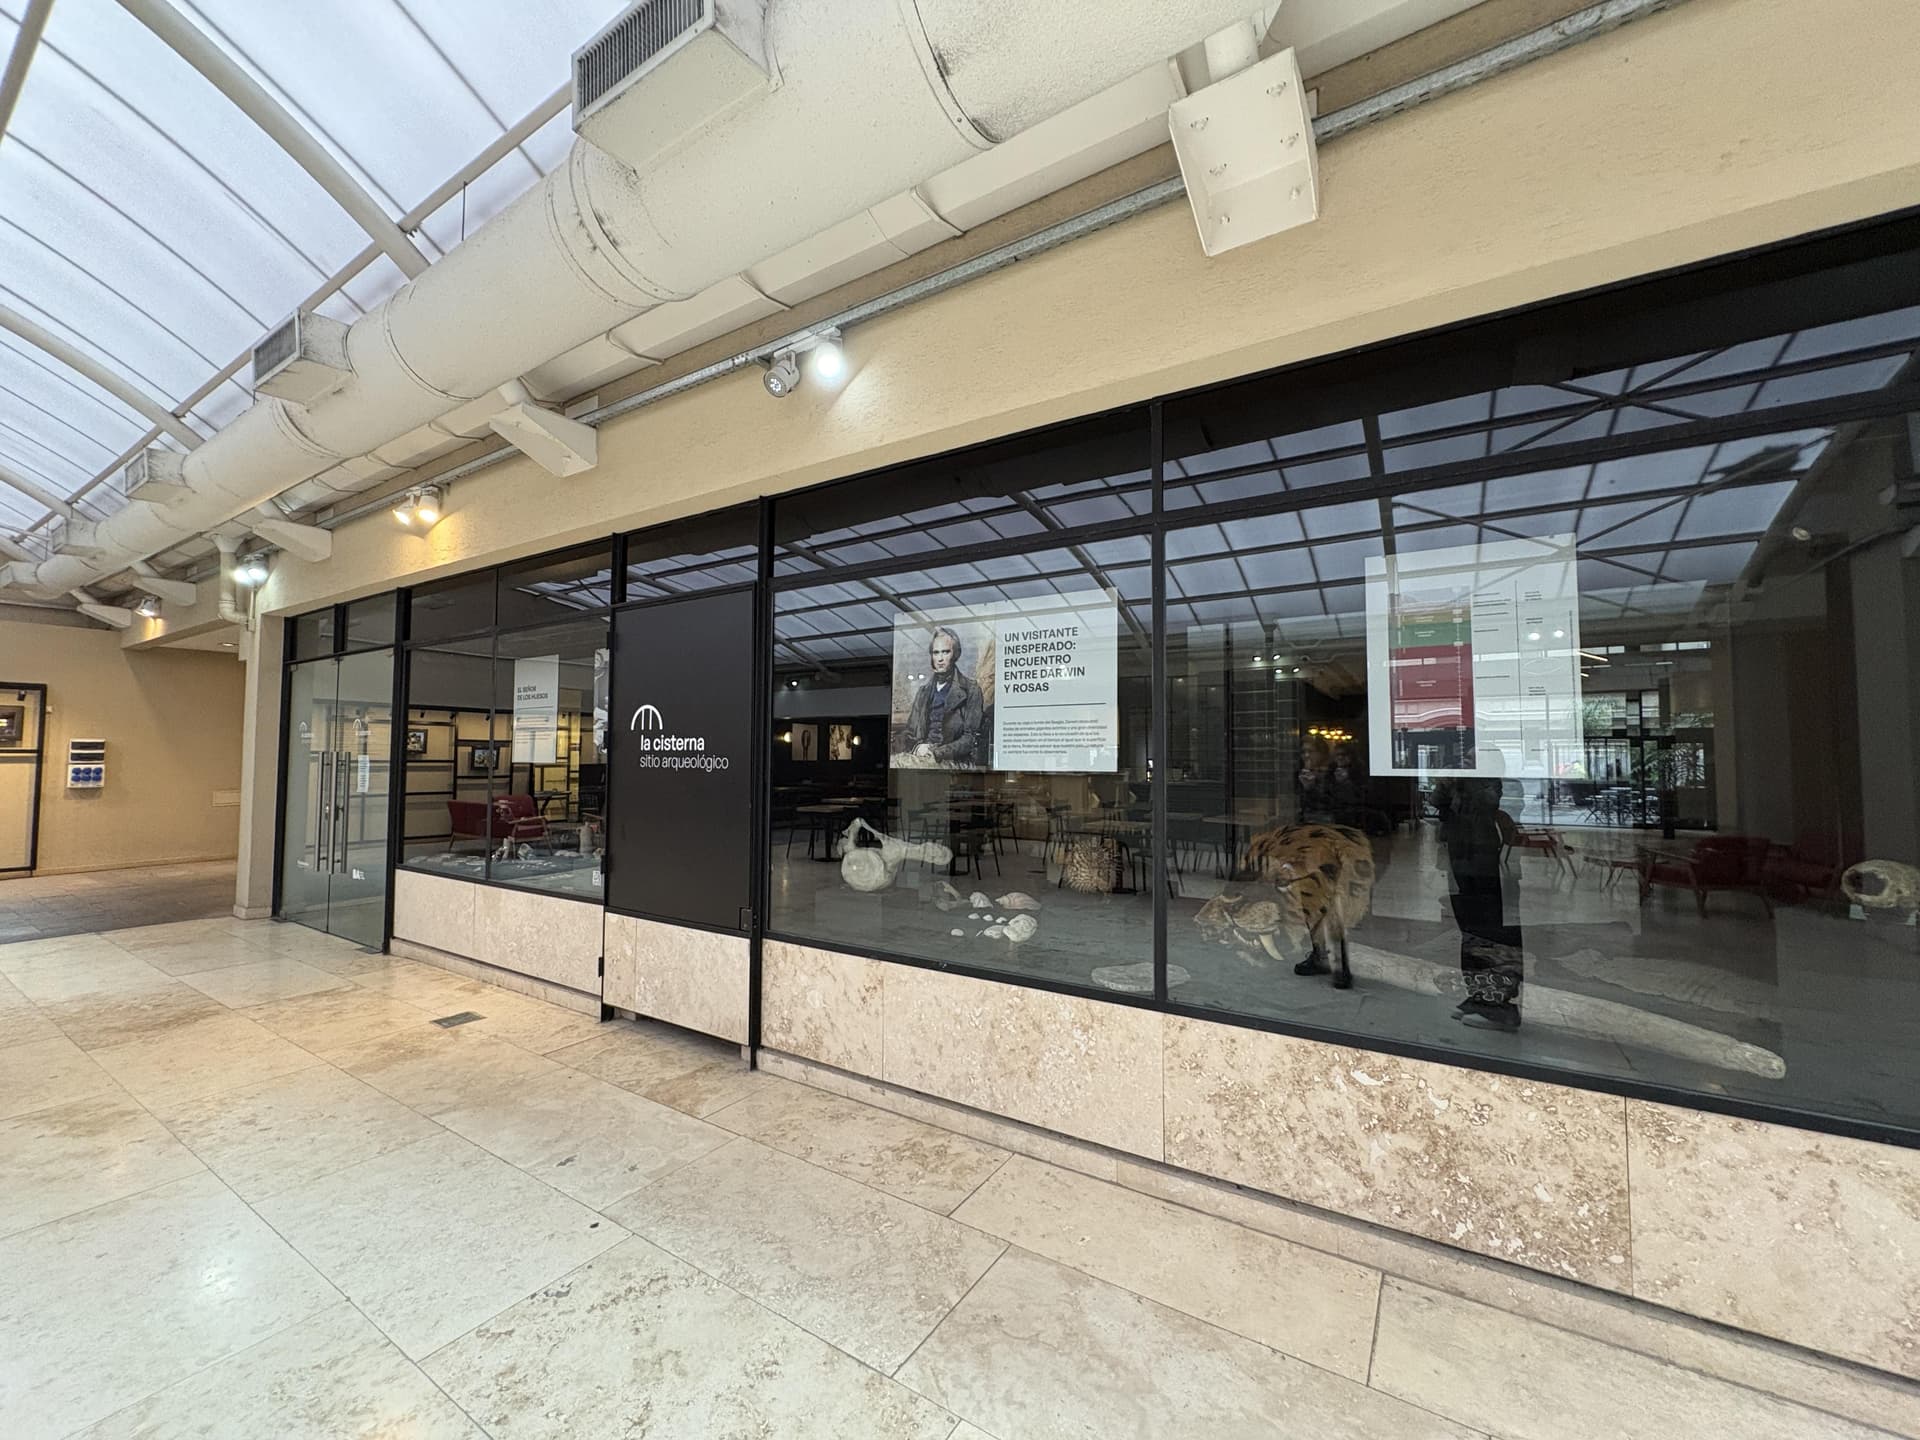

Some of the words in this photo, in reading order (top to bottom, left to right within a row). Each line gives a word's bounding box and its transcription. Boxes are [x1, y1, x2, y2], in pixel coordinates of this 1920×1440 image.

[1004, 632, 1020, 642] UN
[1022, 626, 1079, 641] VISITANTE
[1004, 640, 1077, 655] INESPERADO:
[1004, 654, 1072, 668] ENCUENTRO
[1004, 670, 1038, 681] ENTRE
[1040, 666, 1086, 679] DARWIN
[1003, 684, 1011, 694] Y
[1013, 682, 1050, 693] ROSAS
[640, 734, 651, 751] la
[653, 734, 705, 751] cisterna
[640, 754, 661, 768] sitio
[661, 753, 729, 773] arqueológico
